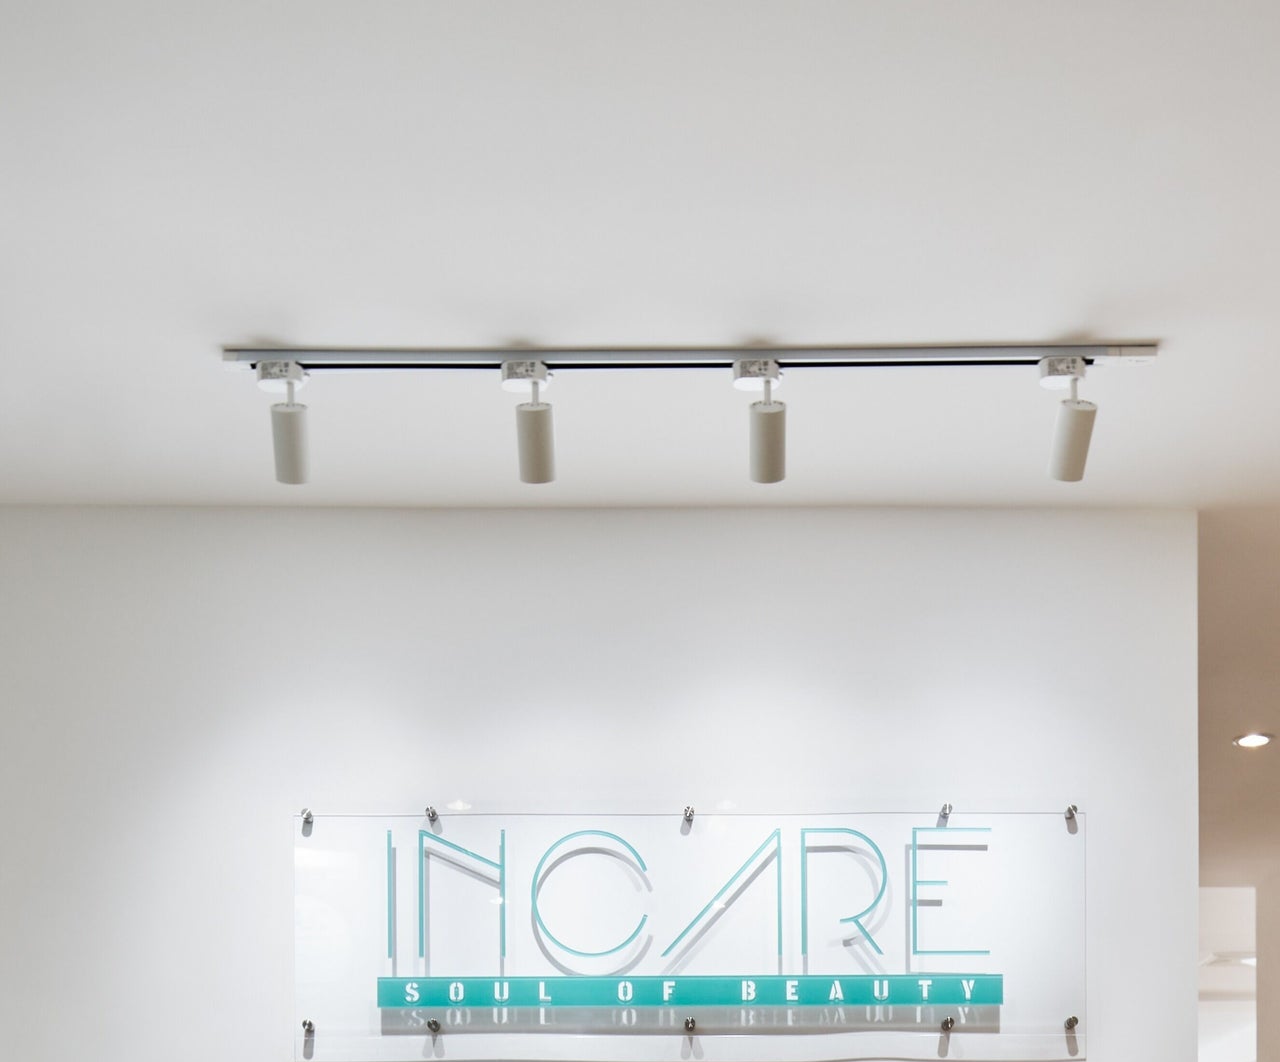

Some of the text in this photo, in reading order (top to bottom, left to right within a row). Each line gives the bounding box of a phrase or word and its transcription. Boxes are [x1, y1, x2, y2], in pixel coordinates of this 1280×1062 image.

[387, 827, 992, 958] INCARE
[405, 980, 976, 1002] SOUL OF BEAUTY
